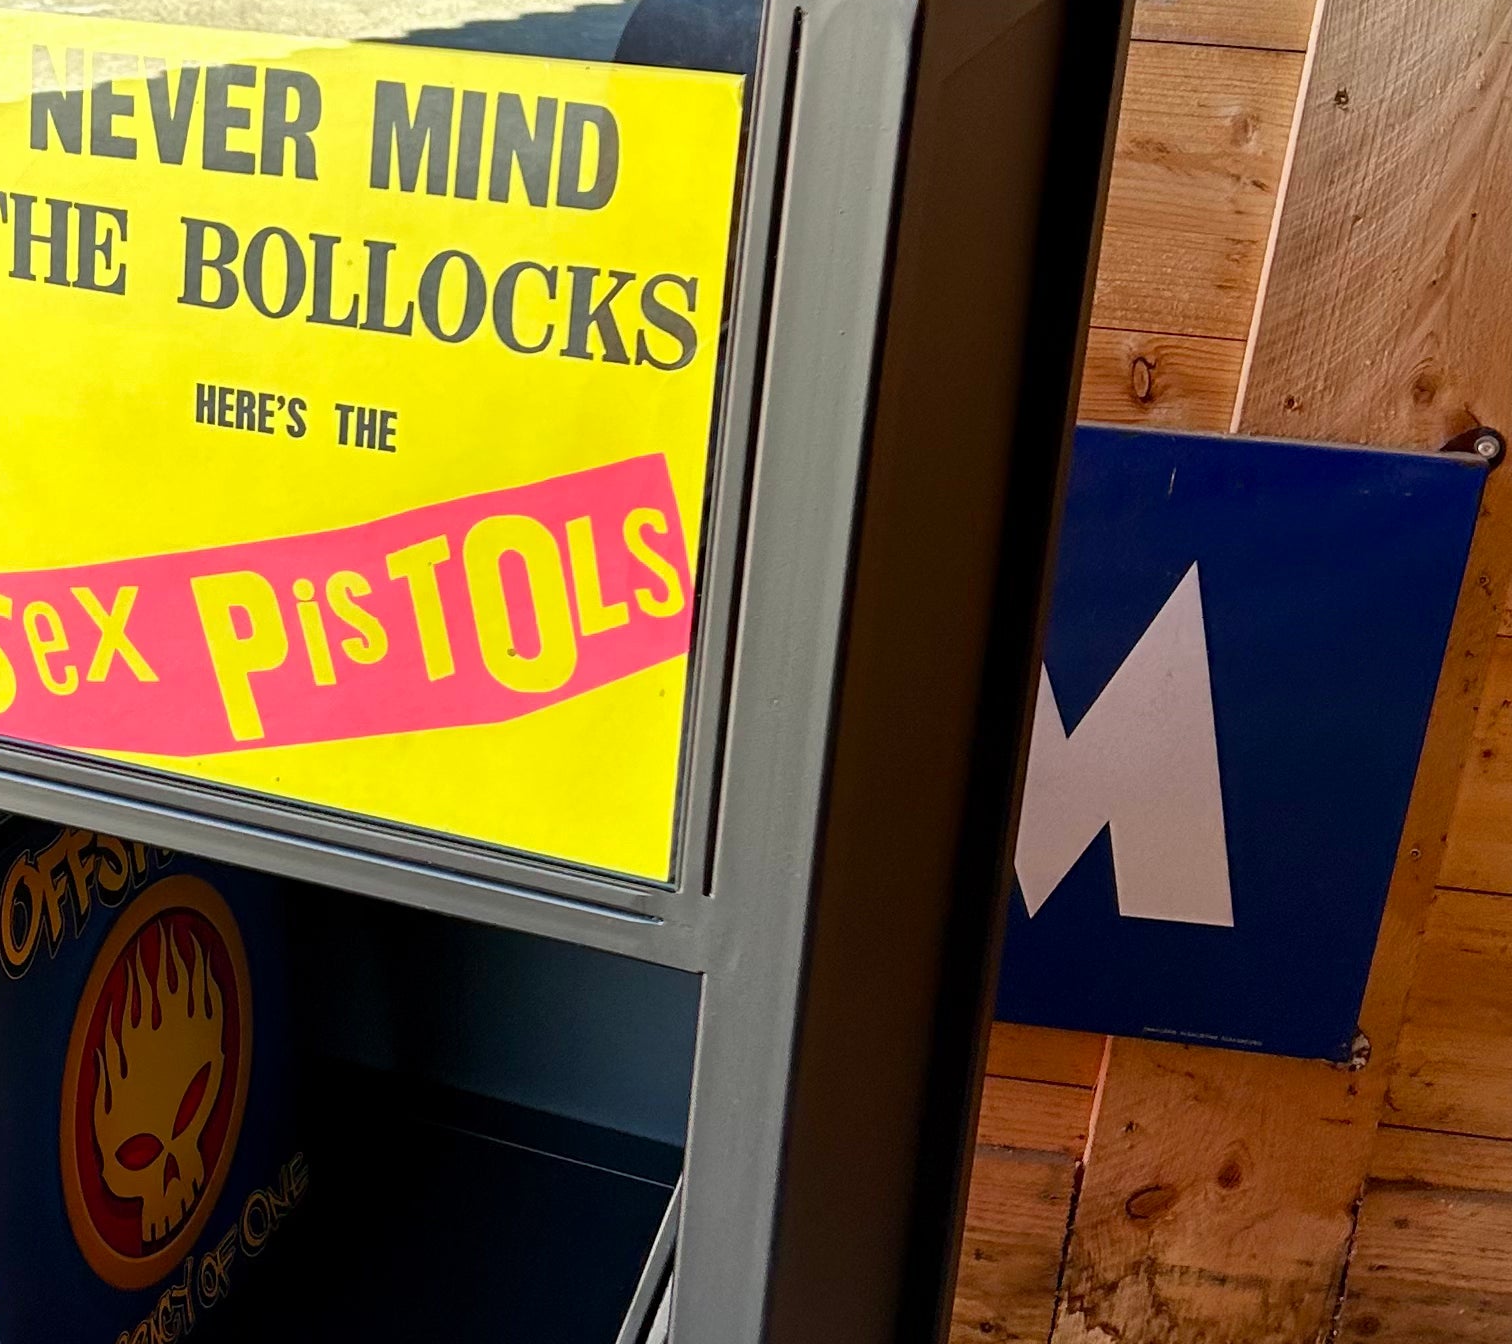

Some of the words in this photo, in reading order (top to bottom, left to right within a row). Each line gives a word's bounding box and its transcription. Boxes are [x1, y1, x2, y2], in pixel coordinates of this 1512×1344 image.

[30, 44, 322, 181] NEVER
[370, 80, 621, 211] MIND
[178, 215, 698, 372] BOLLOCKS
[195, 383, 307, 438] HERE'S
[334, 402, 397, 453] THE
